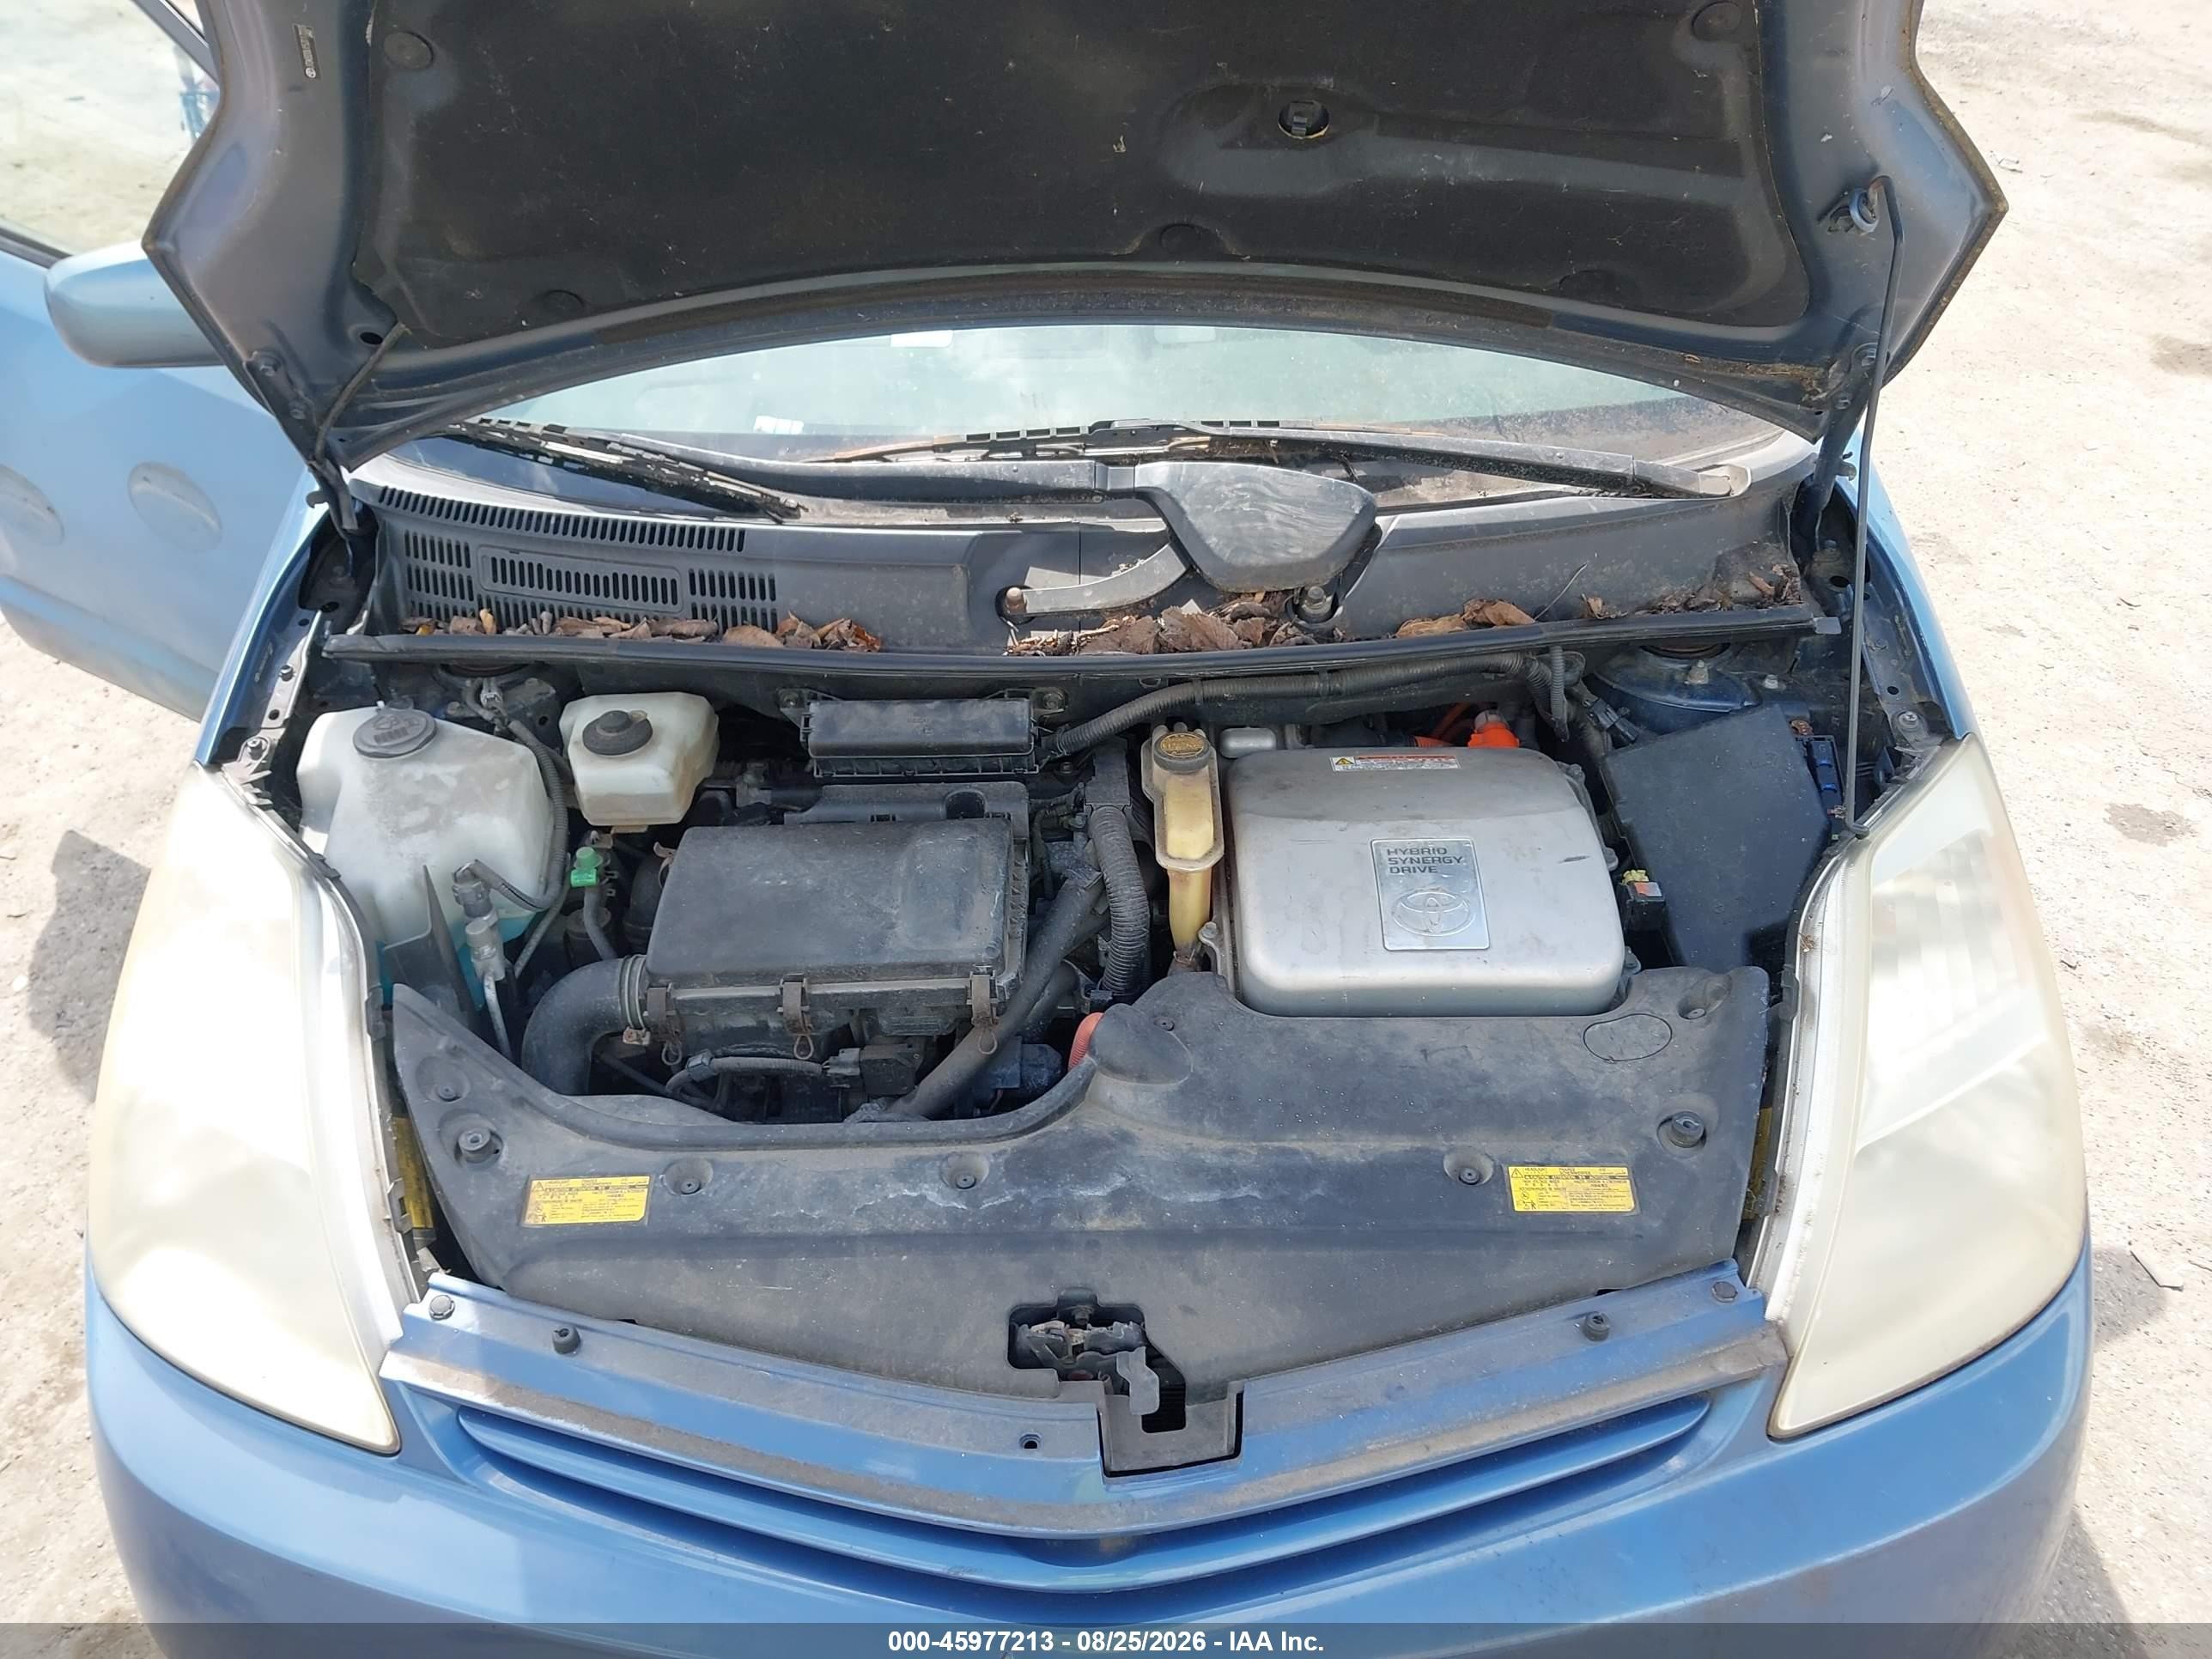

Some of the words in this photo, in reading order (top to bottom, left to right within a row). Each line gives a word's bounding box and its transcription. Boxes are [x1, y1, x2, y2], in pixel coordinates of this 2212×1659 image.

[1387, 847, 1448, 856] HYBRID
[1388, 855, 1463, 866] SYNERGY
[1389, 866, 1438, 874] DRIVE
